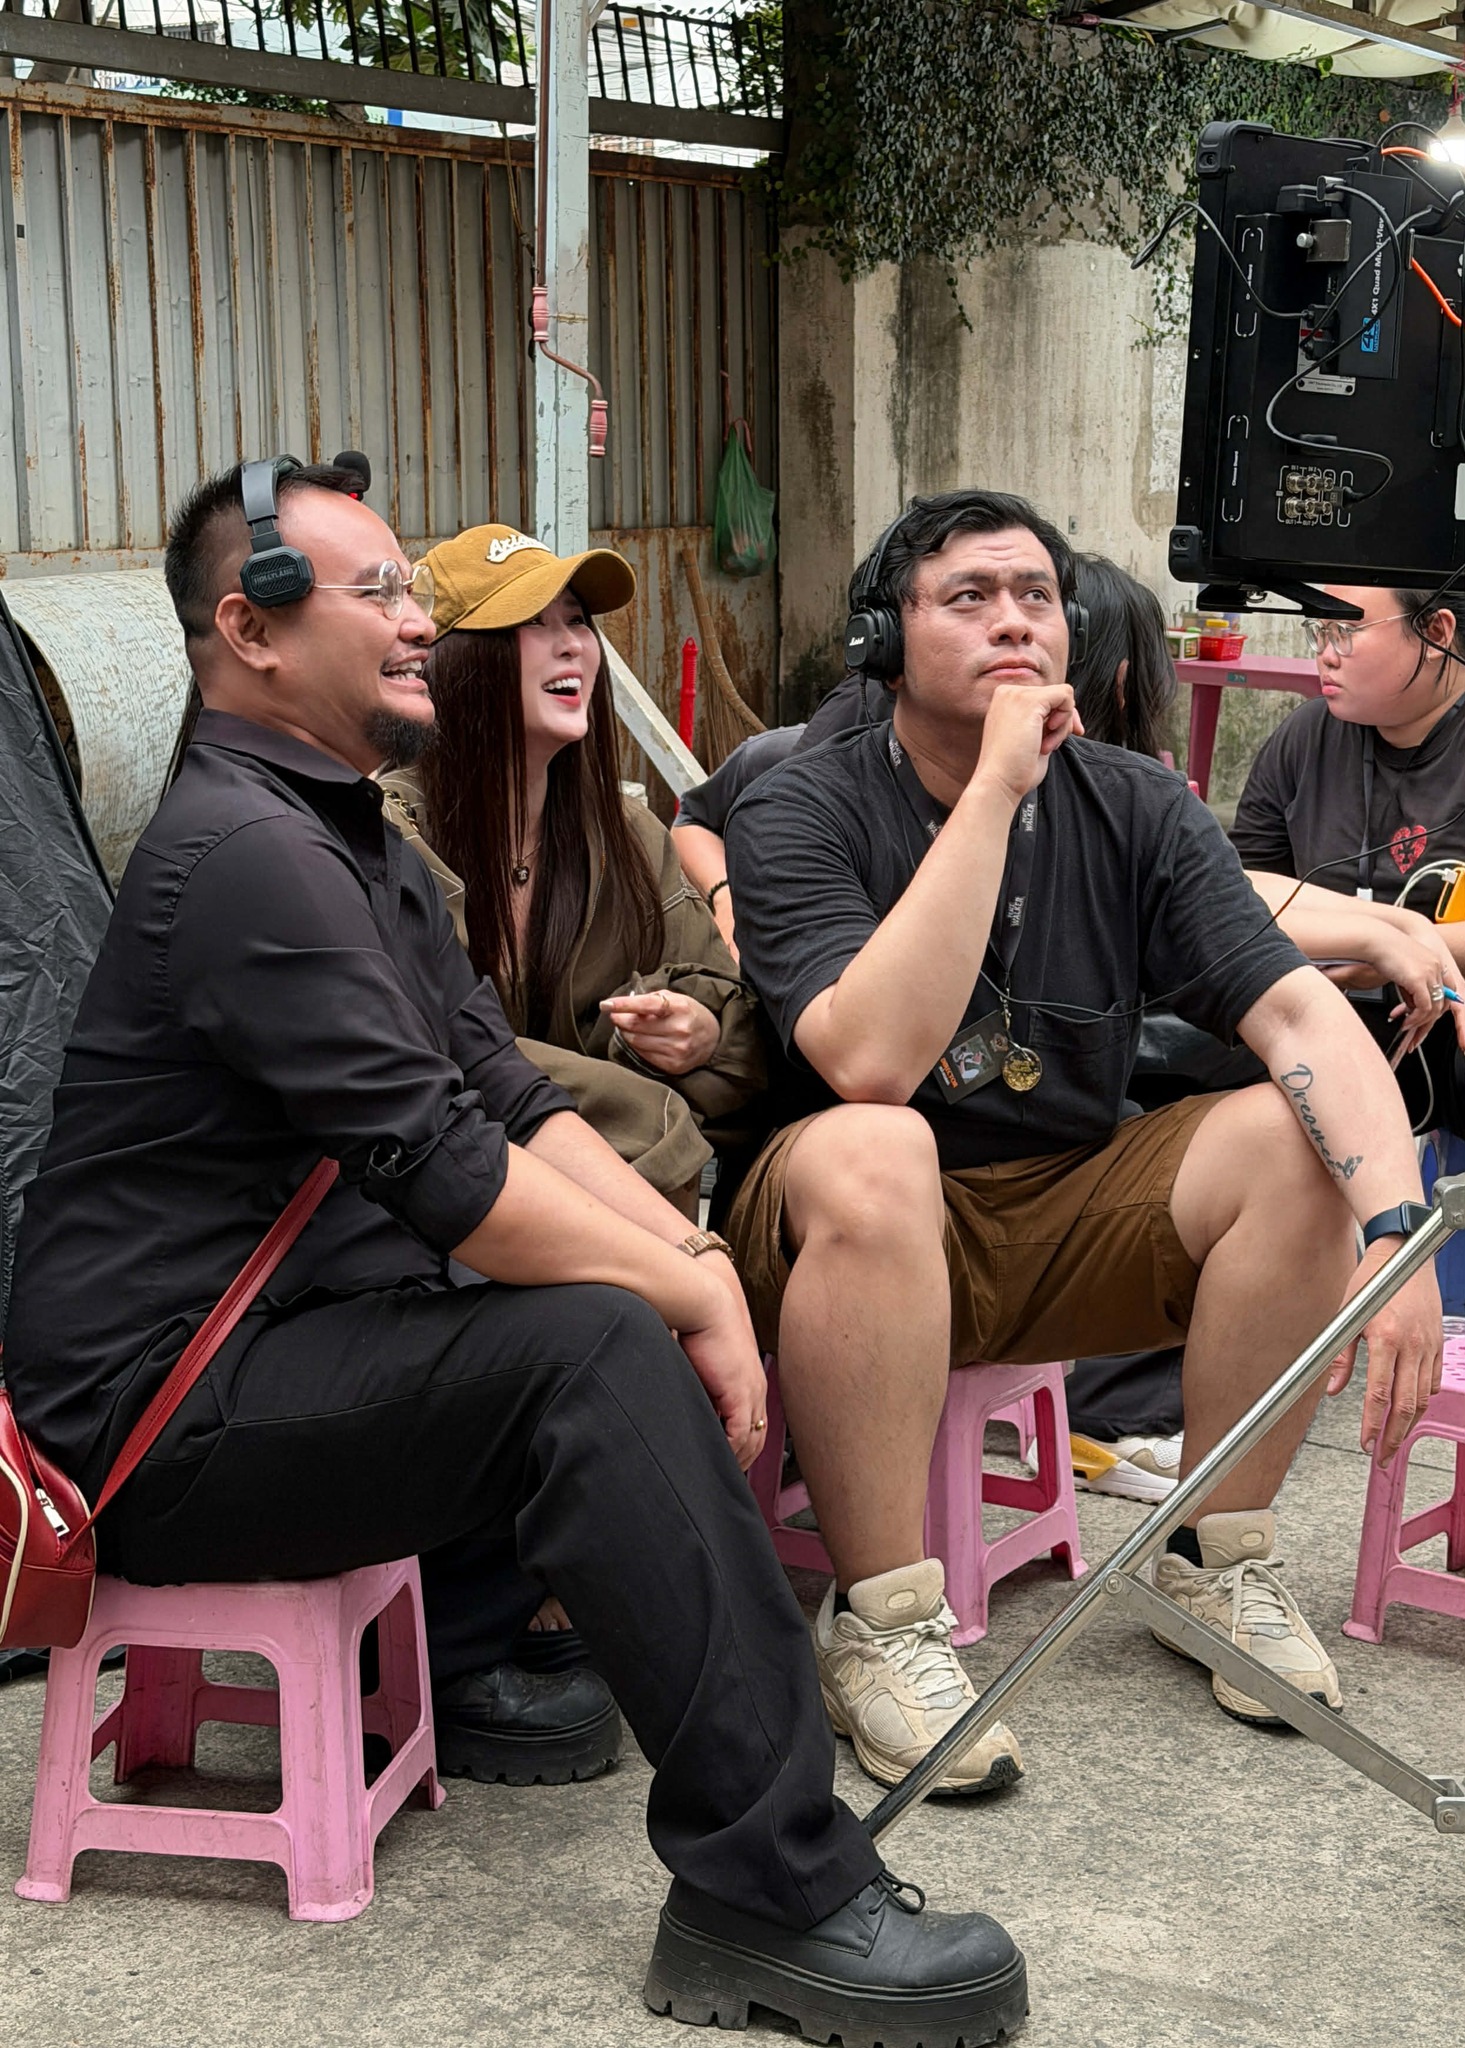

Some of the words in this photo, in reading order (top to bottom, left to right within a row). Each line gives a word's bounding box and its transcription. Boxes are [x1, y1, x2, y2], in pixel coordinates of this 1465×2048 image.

[1372, 267, 1382, 295] Quad
[253, 567, 294, 584] HOLLYLAND
[1025, 803, 1035, 833] WALKER
[1010, 896, 1024, 928] WALKER
[838, 1655, 873, 1702] N
